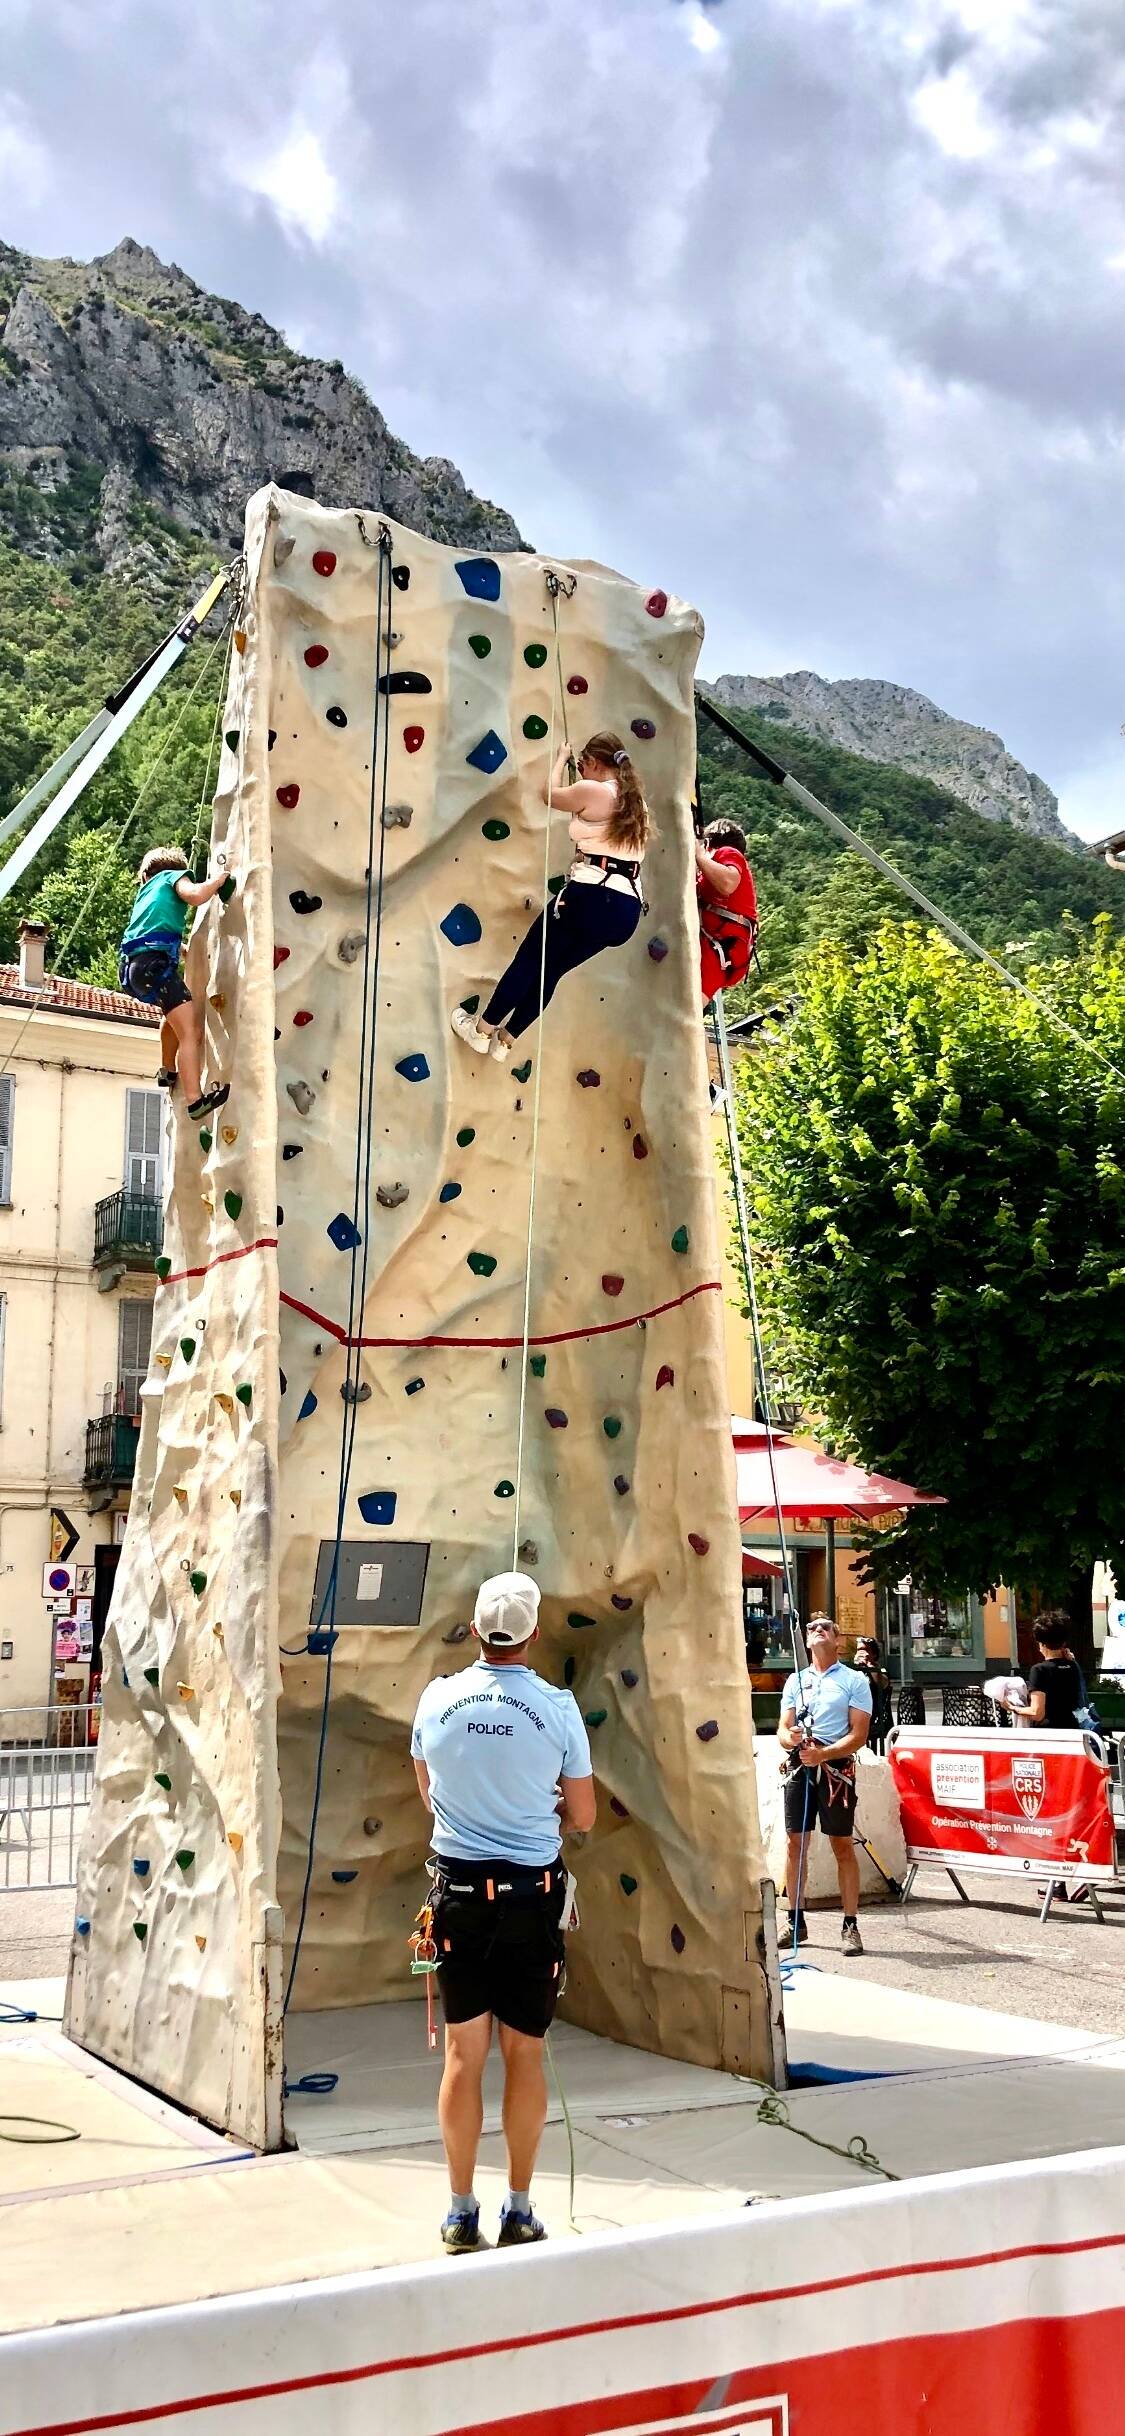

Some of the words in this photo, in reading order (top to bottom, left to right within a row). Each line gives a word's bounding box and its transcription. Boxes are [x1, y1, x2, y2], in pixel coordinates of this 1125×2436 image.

[439, 1694, 493, 1725] PREVENTION
[497, 1694, 546, 1732] MONTAGNE
[467, 1722, 514, 1736] POLICE
[936, 1763, 980, 1773] association
[937, 1784, 956, 1793] MAIF
[1015, 1777, 1042, 1793] CRS
[931, 1815, 969, 1829] Opération
[969, 1819, 1012, 1833] Prévention
[1013, 1822, 1053, 1838] Montagne
